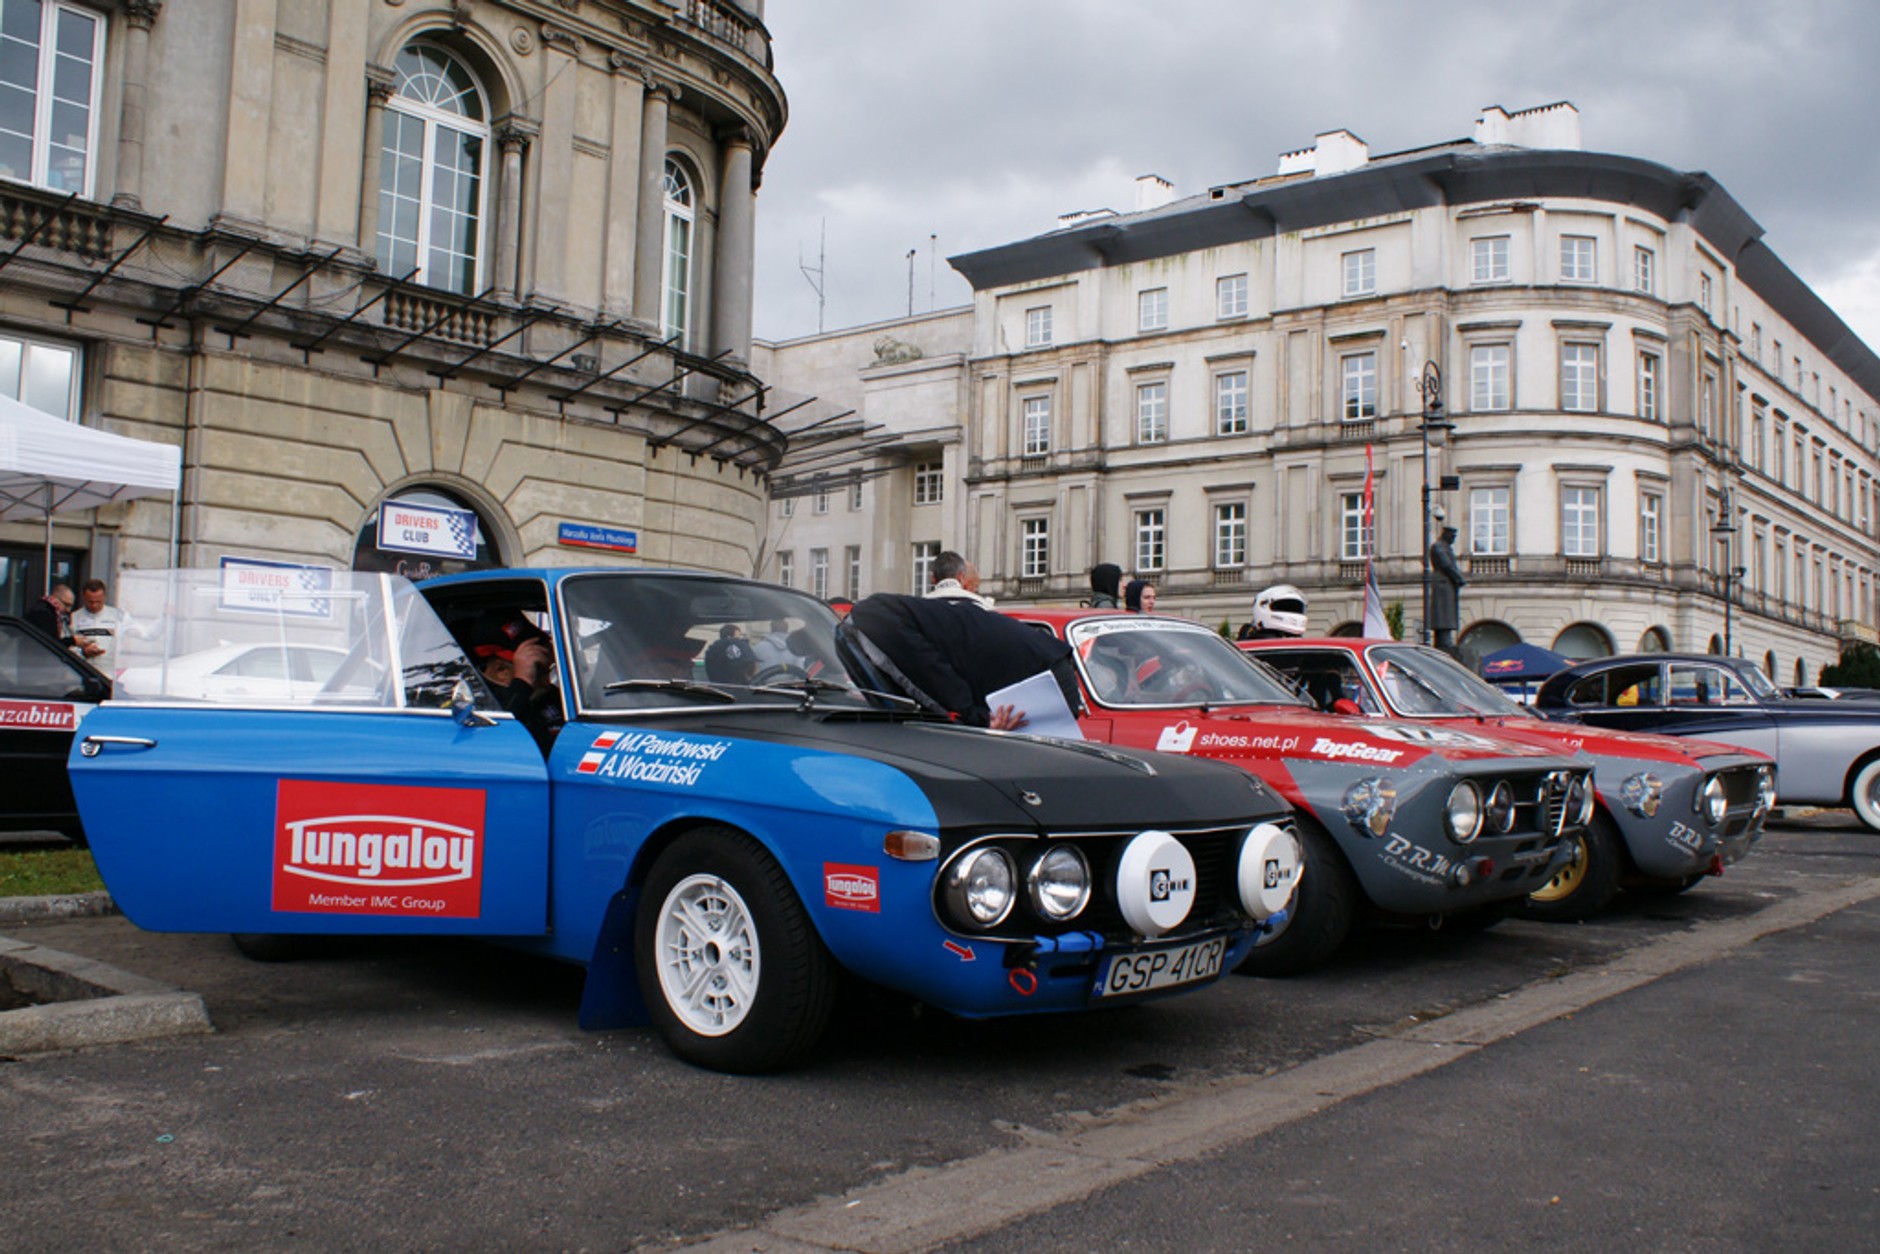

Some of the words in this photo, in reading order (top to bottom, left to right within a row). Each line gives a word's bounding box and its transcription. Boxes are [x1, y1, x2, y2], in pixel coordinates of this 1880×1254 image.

[394, 513, 439, 530] DRIVERS
[402, 529, 429, 543] CLUB
[238, 570, 290, 588] DRIVERS
[1200, 732, 1300, 752] shoes.net.pl
[1310, 737, 1404, 763] TopGear
[284, 816, 475, 882] Tungaloy
[826, 874, 877, 900] Tungaloy
[308, 893, 366, 907] Member
[370, 895, 398, 908] IMC
[401, 896, 446, 912] Group
[1110, 953, 1168, 993] GSP
[1170, 941, 1221, 981] 41CR
